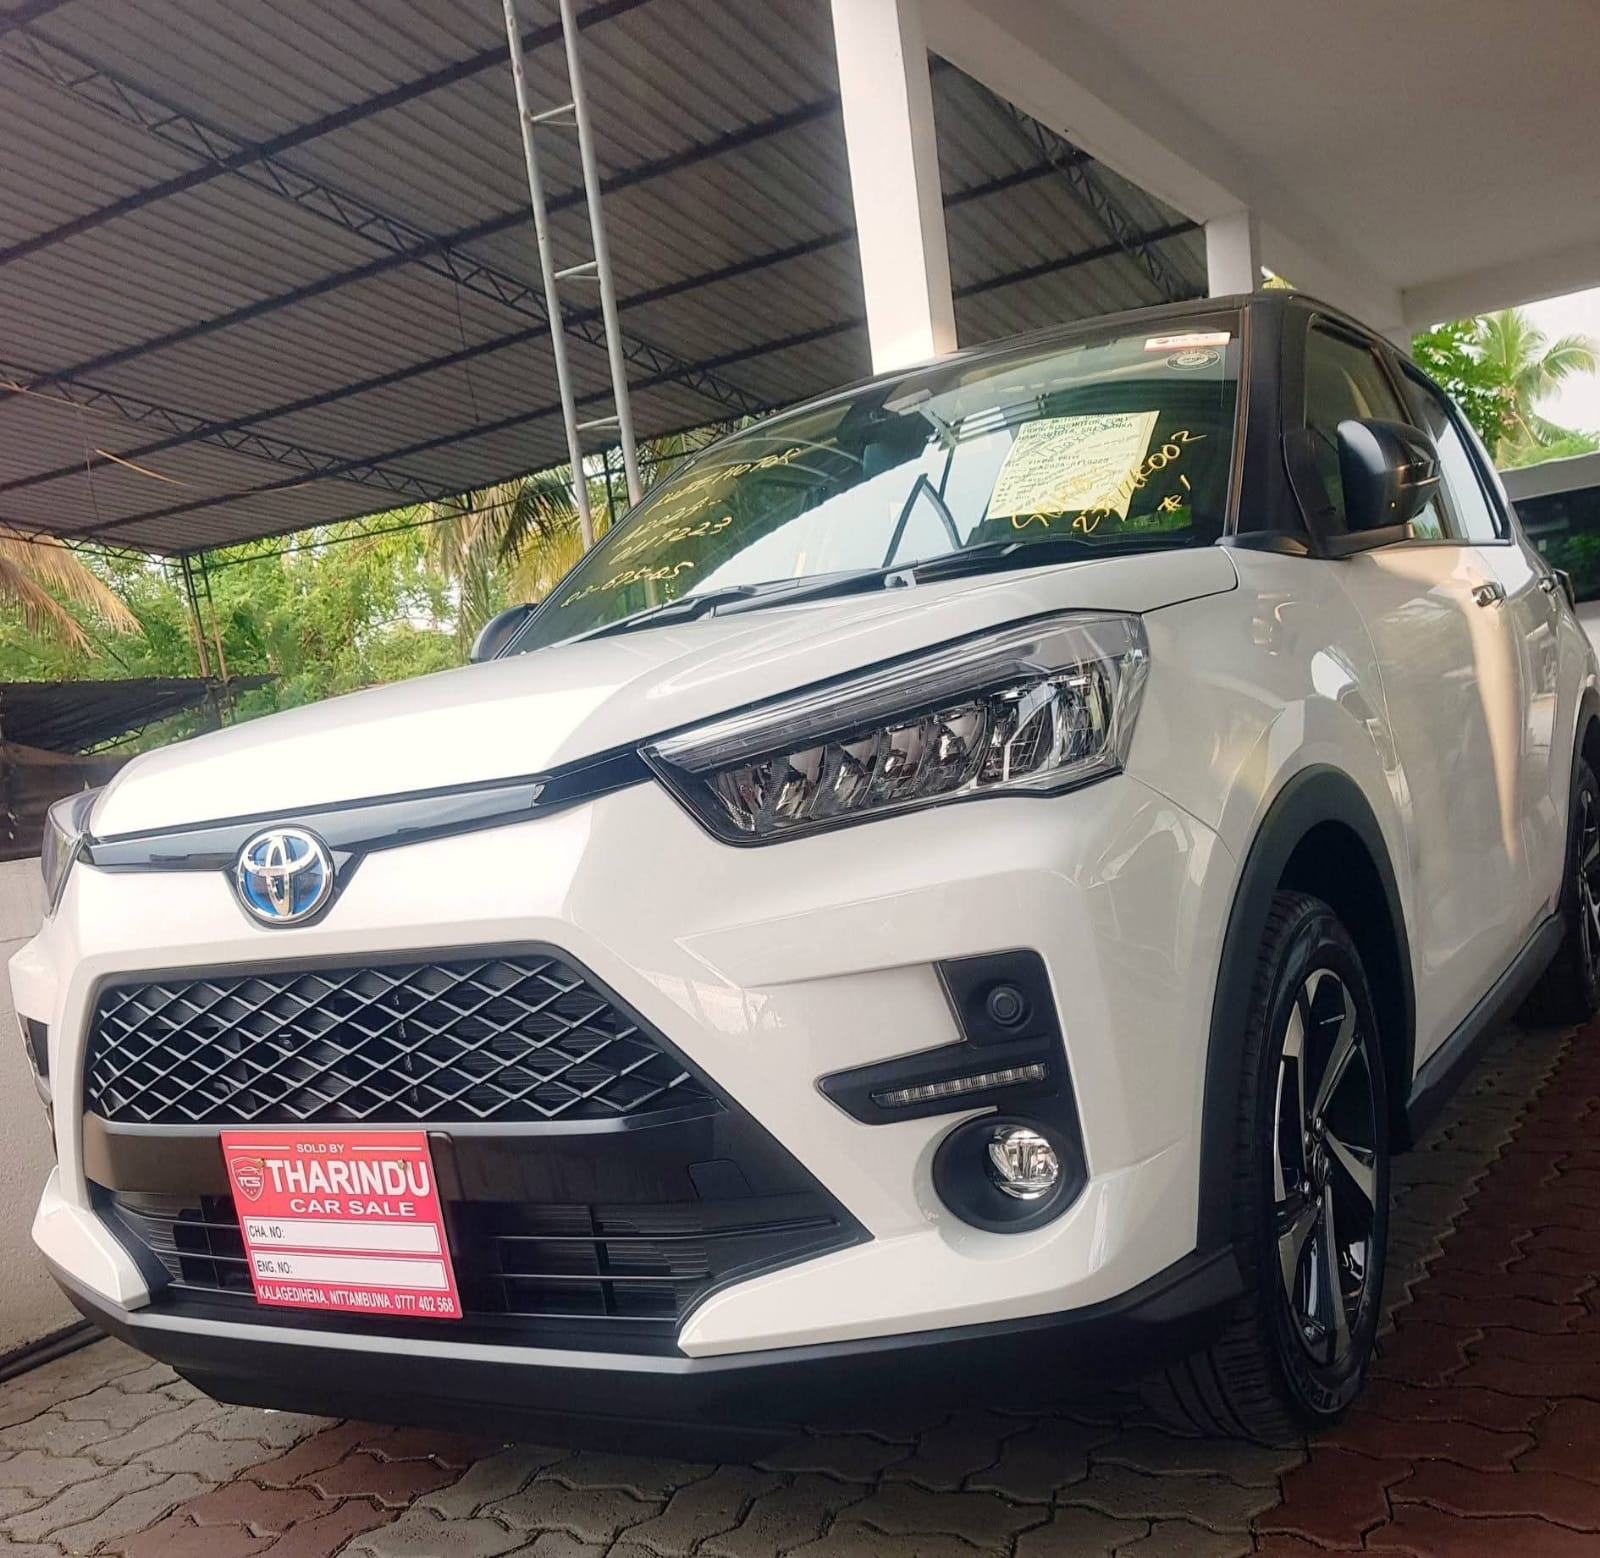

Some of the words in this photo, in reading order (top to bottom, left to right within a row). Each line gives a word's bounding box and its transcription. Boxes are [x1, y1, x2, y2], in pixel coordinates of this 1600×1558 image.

[297, 1143, 326, 1153] SOLD
[329, 1143, 345, 1154] BY
[266, 1159, 430, 1196] THARINDU
[289, 1199, 343, 1214] CAR
[348, 1200, 417, 1217] SALE
[395, 1294, 416, 1311] 0777
[418, 1296, 436, 1312] 402
[436, 1297, 454, 1313] 568
